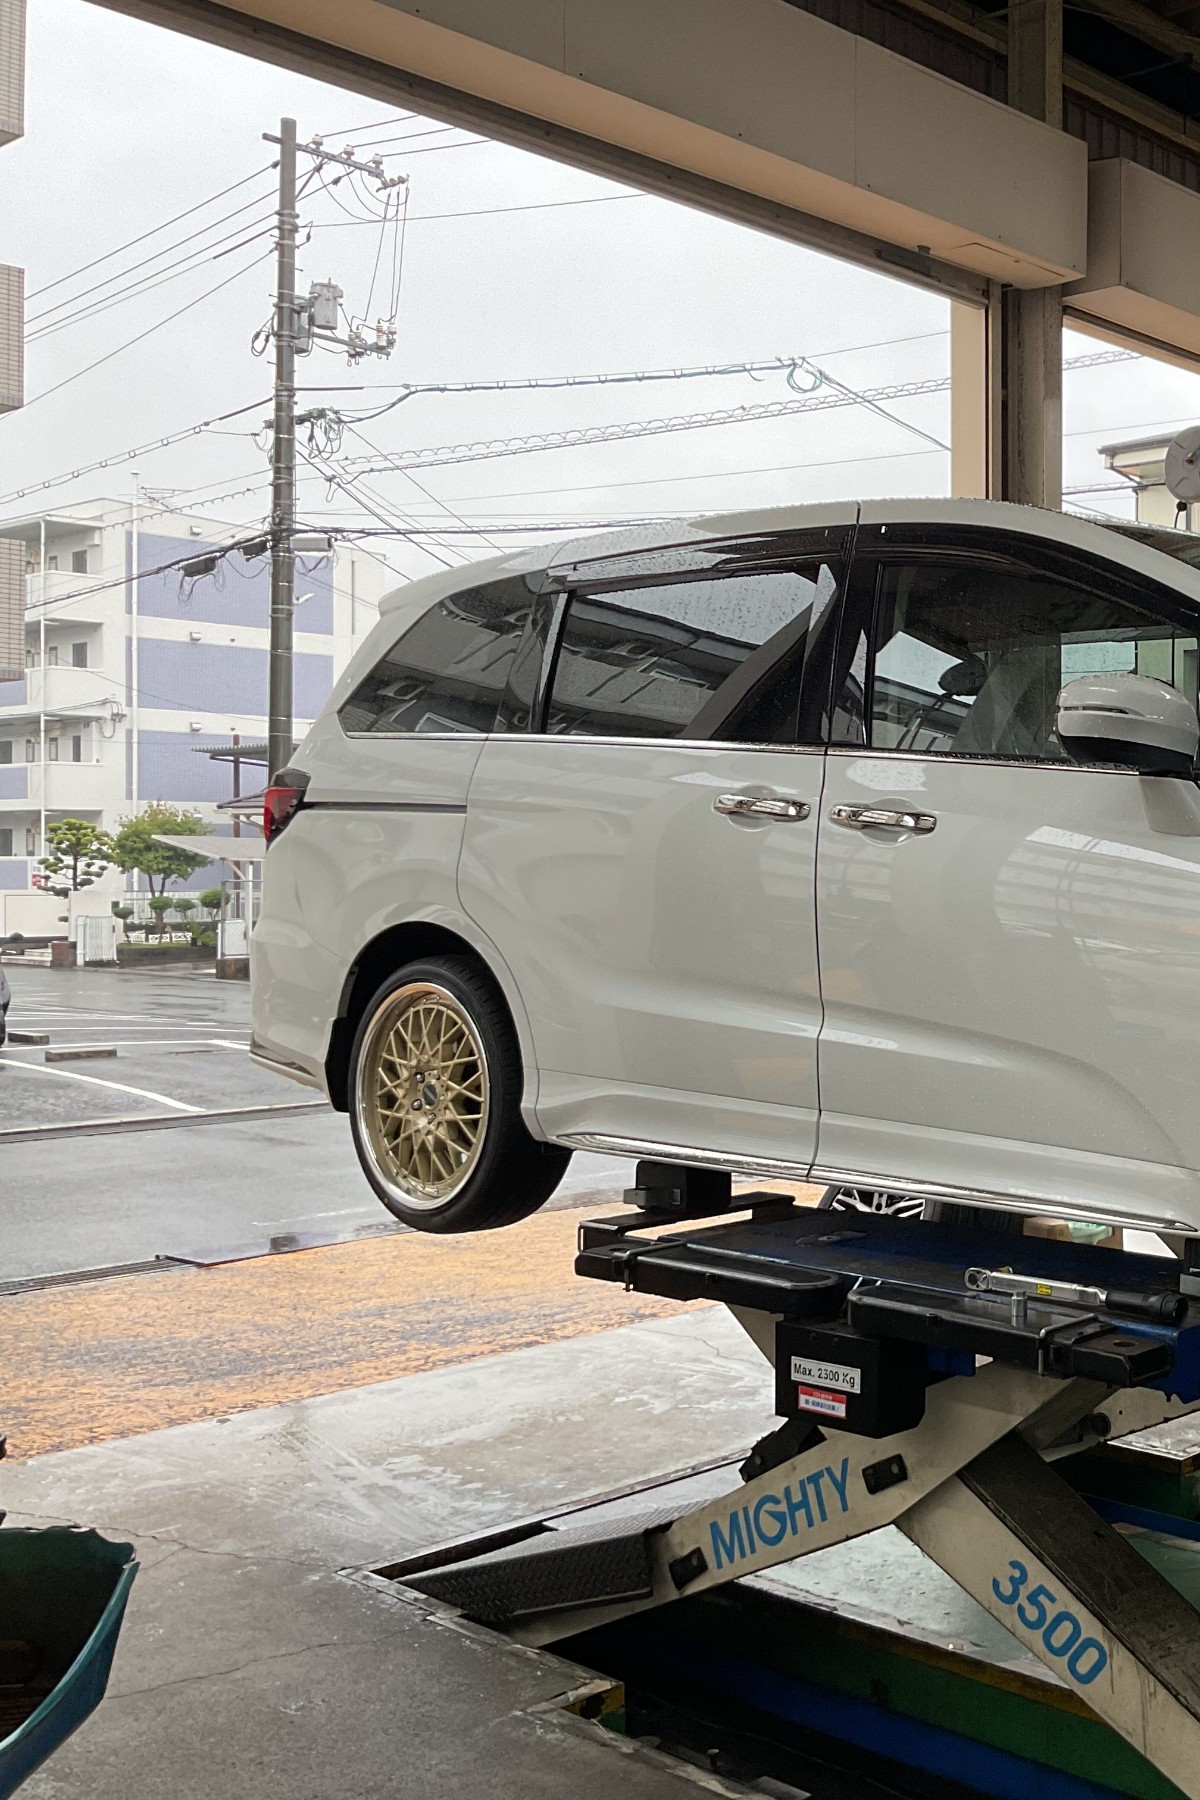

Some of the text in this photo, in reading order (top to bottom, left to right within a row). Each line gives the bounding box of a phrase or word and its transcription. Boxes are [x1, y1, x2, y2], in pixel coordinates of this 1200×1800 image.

[794, 1363, 815, 1378] Max.
[842, 1372, 855, 1388] Kg
[709, 1457, 849, 1570] MIGHTY
[992, 1559, 1108, 1685] 3500
